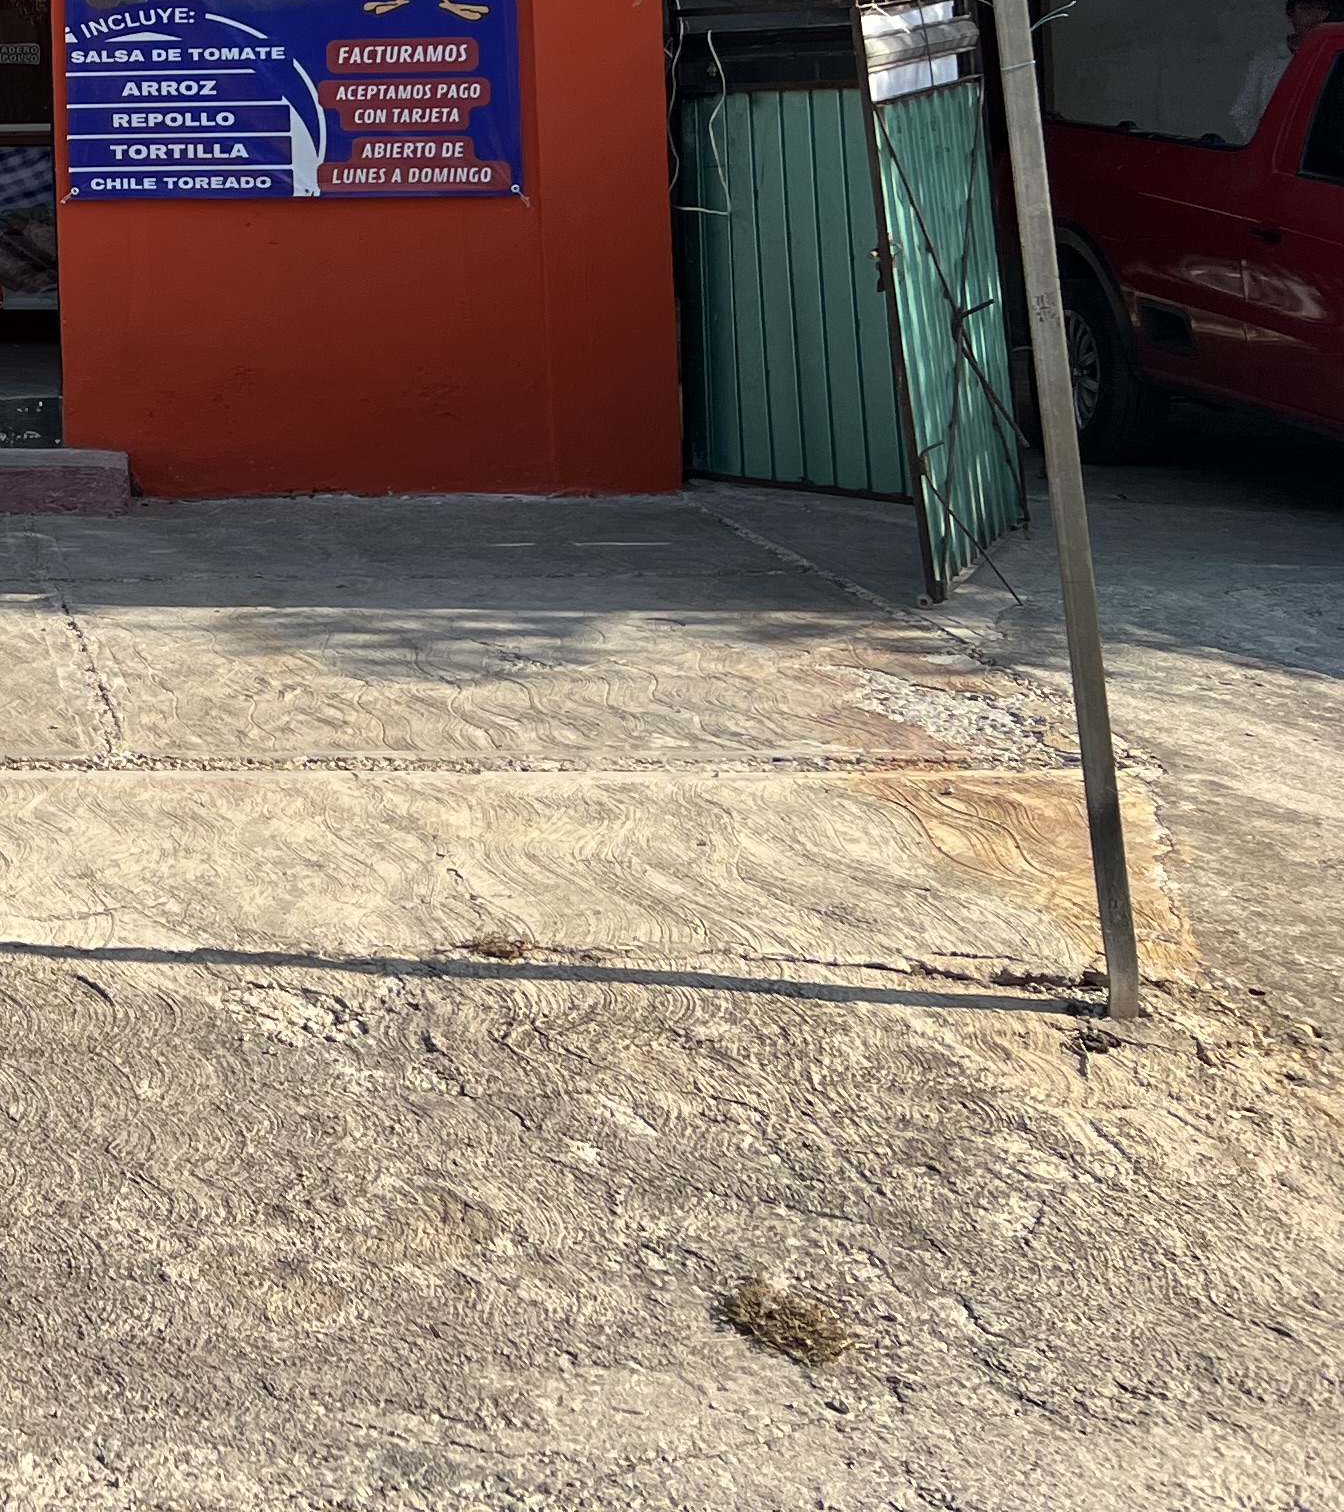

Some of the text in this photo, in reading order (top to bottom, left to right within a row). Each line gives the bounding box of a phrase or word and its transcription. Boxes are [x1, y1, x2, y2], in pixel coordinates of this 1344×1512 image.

[80, 7, 196, 38] INCLUYE:
[71, 47, 285, 63] SALSA DE TOMATE
[338, 44, 468, 64] FACTURAMOS
[122, 80, 217, 97] ARROZ
[336, 82, 481, 101] ACEPTAMOS PAGO
[112, 111, 235, 128] REPOLLO
[354, 106, 461, 125] CON TARJETA
[110, 143, 249, 160] TORTILLA
[361, 141, 464, 159] ABIERTO DE
[90, 174, 272, 191] CHILE TOREADO
[332, 166, 492, 185] LUNES A DOMINGO
